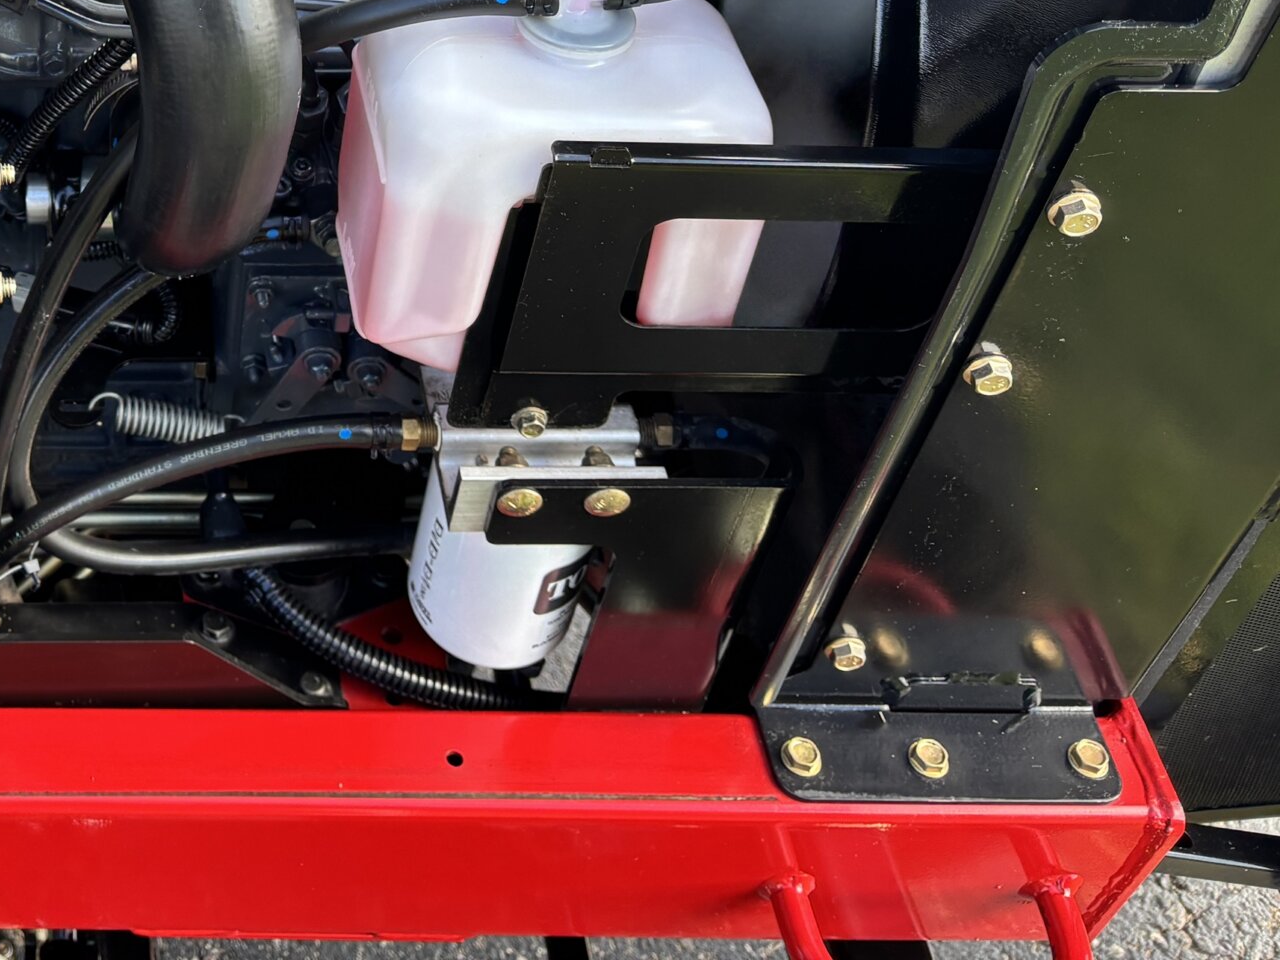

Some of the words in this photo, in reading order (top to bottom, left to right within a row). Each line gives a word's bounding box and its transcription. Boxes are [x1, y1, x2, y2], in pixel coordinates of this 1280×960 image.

[256, 427, 300, 442] AKWEL
[179, 438, 248, 464] GREENBAR
[107, 459, 172, 491] STANDARD
